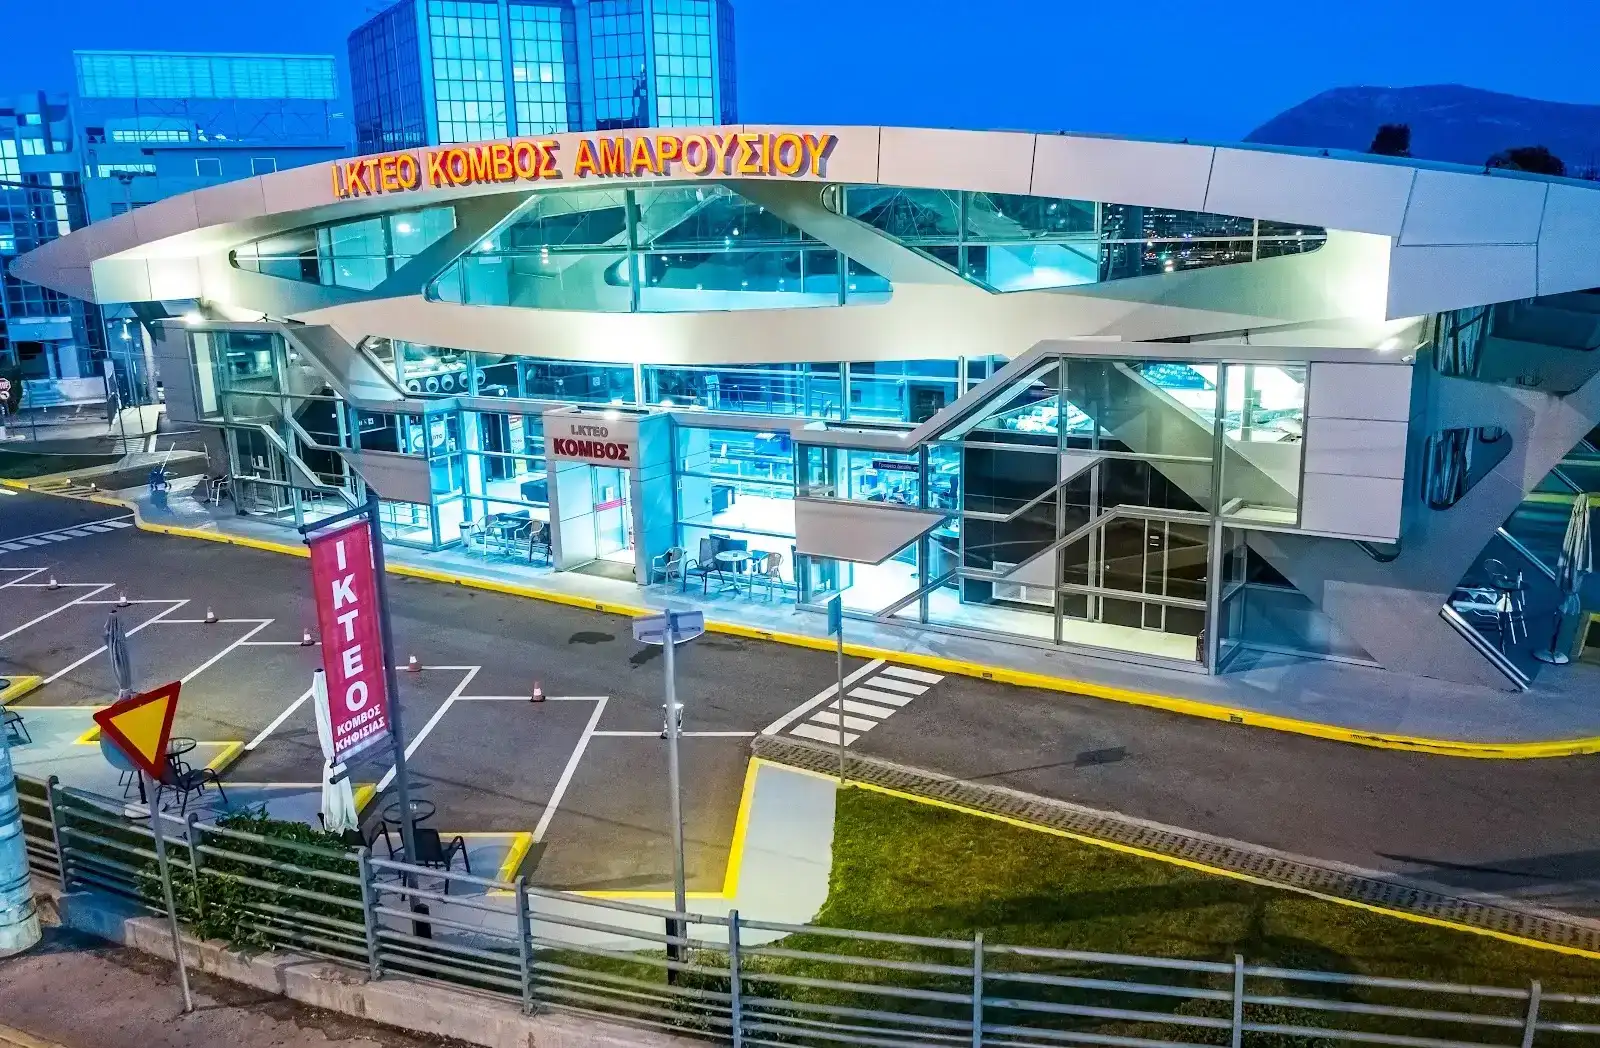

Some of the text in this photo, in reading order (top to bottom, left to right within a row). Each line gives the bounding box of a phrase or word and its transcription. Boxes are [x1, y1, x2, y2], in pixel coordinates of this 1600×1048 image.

[332, 133, 837, 198] Ι.ΚΤΕΟ ΚΟΜΒΟΣ ΑΜΑΡΟΥΣΙΟΥ
[571, 425, 608, 437] Ι.ΚΤΕΟ
[553, 438, 630, 460] ΚΟΜΒΟΣ
[331, 540, 368, 712] ΙΚΤΕΟ
[336, 716, 385, 752] ΚΗΦΙΣΙΑΣ
[337, 704, 381, 736] ΚΟΜΒΟΣ
